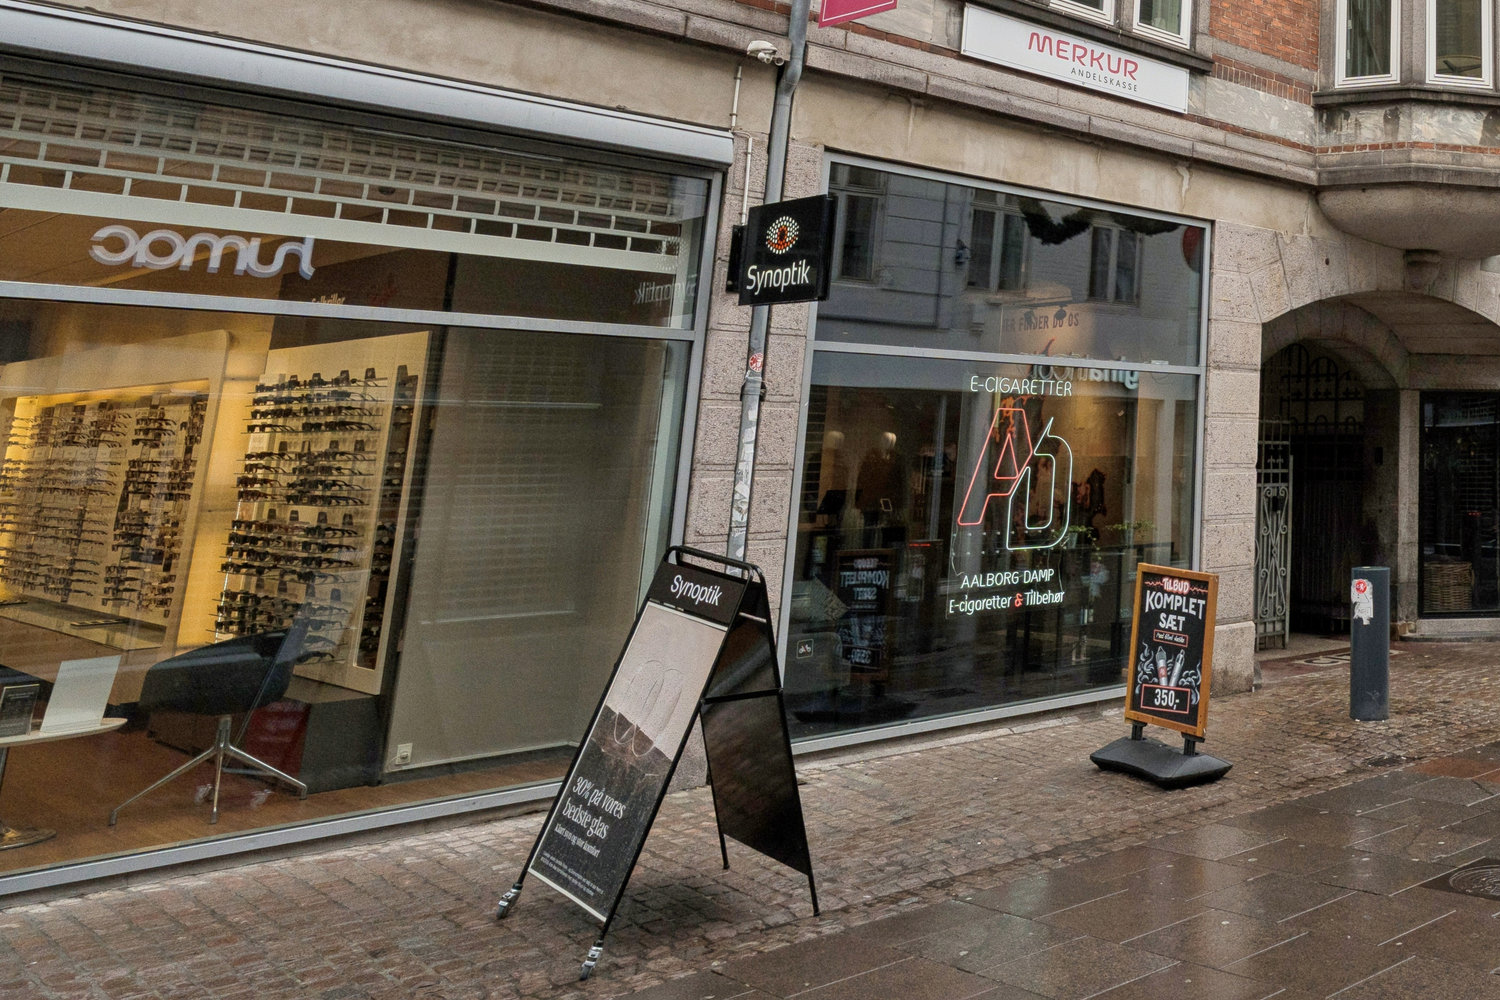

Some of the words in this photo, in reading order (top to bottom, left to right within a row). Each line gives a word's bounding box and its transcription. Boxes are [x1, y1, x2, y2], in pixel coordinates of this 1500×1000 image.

[1028, 32, 1139, 81] MERKUR
[1071, 67, 1138, 92] ANDELSKASSE
[746, 259, 811, 296] Synoptik
[970, 375, 1073, 397] E-CIGARETTER
[670, 574, 723, 606] Synoptik
[960, 570, 1019, 589] AALBORG
[1023, 568, 1055, 584] DAMP
[949, 593, 1012, 615] E-cigaretter
[1014, 592, 1023, 608] &
[1024, 589, 1065, 607] Tilbehør
[1145, 589, 1206, 620] KOMPLET
[1158, 612, 1186, 632] SÆT
[1154, 688, 1180, 711] 350,-
[572, 776, 595, 800] 30%
[587, 787, 604, 807] på
[601, 794, 627, 819] vores
[562, 797, 591, 829] bedste
[587, 816, 610, 839] glas
